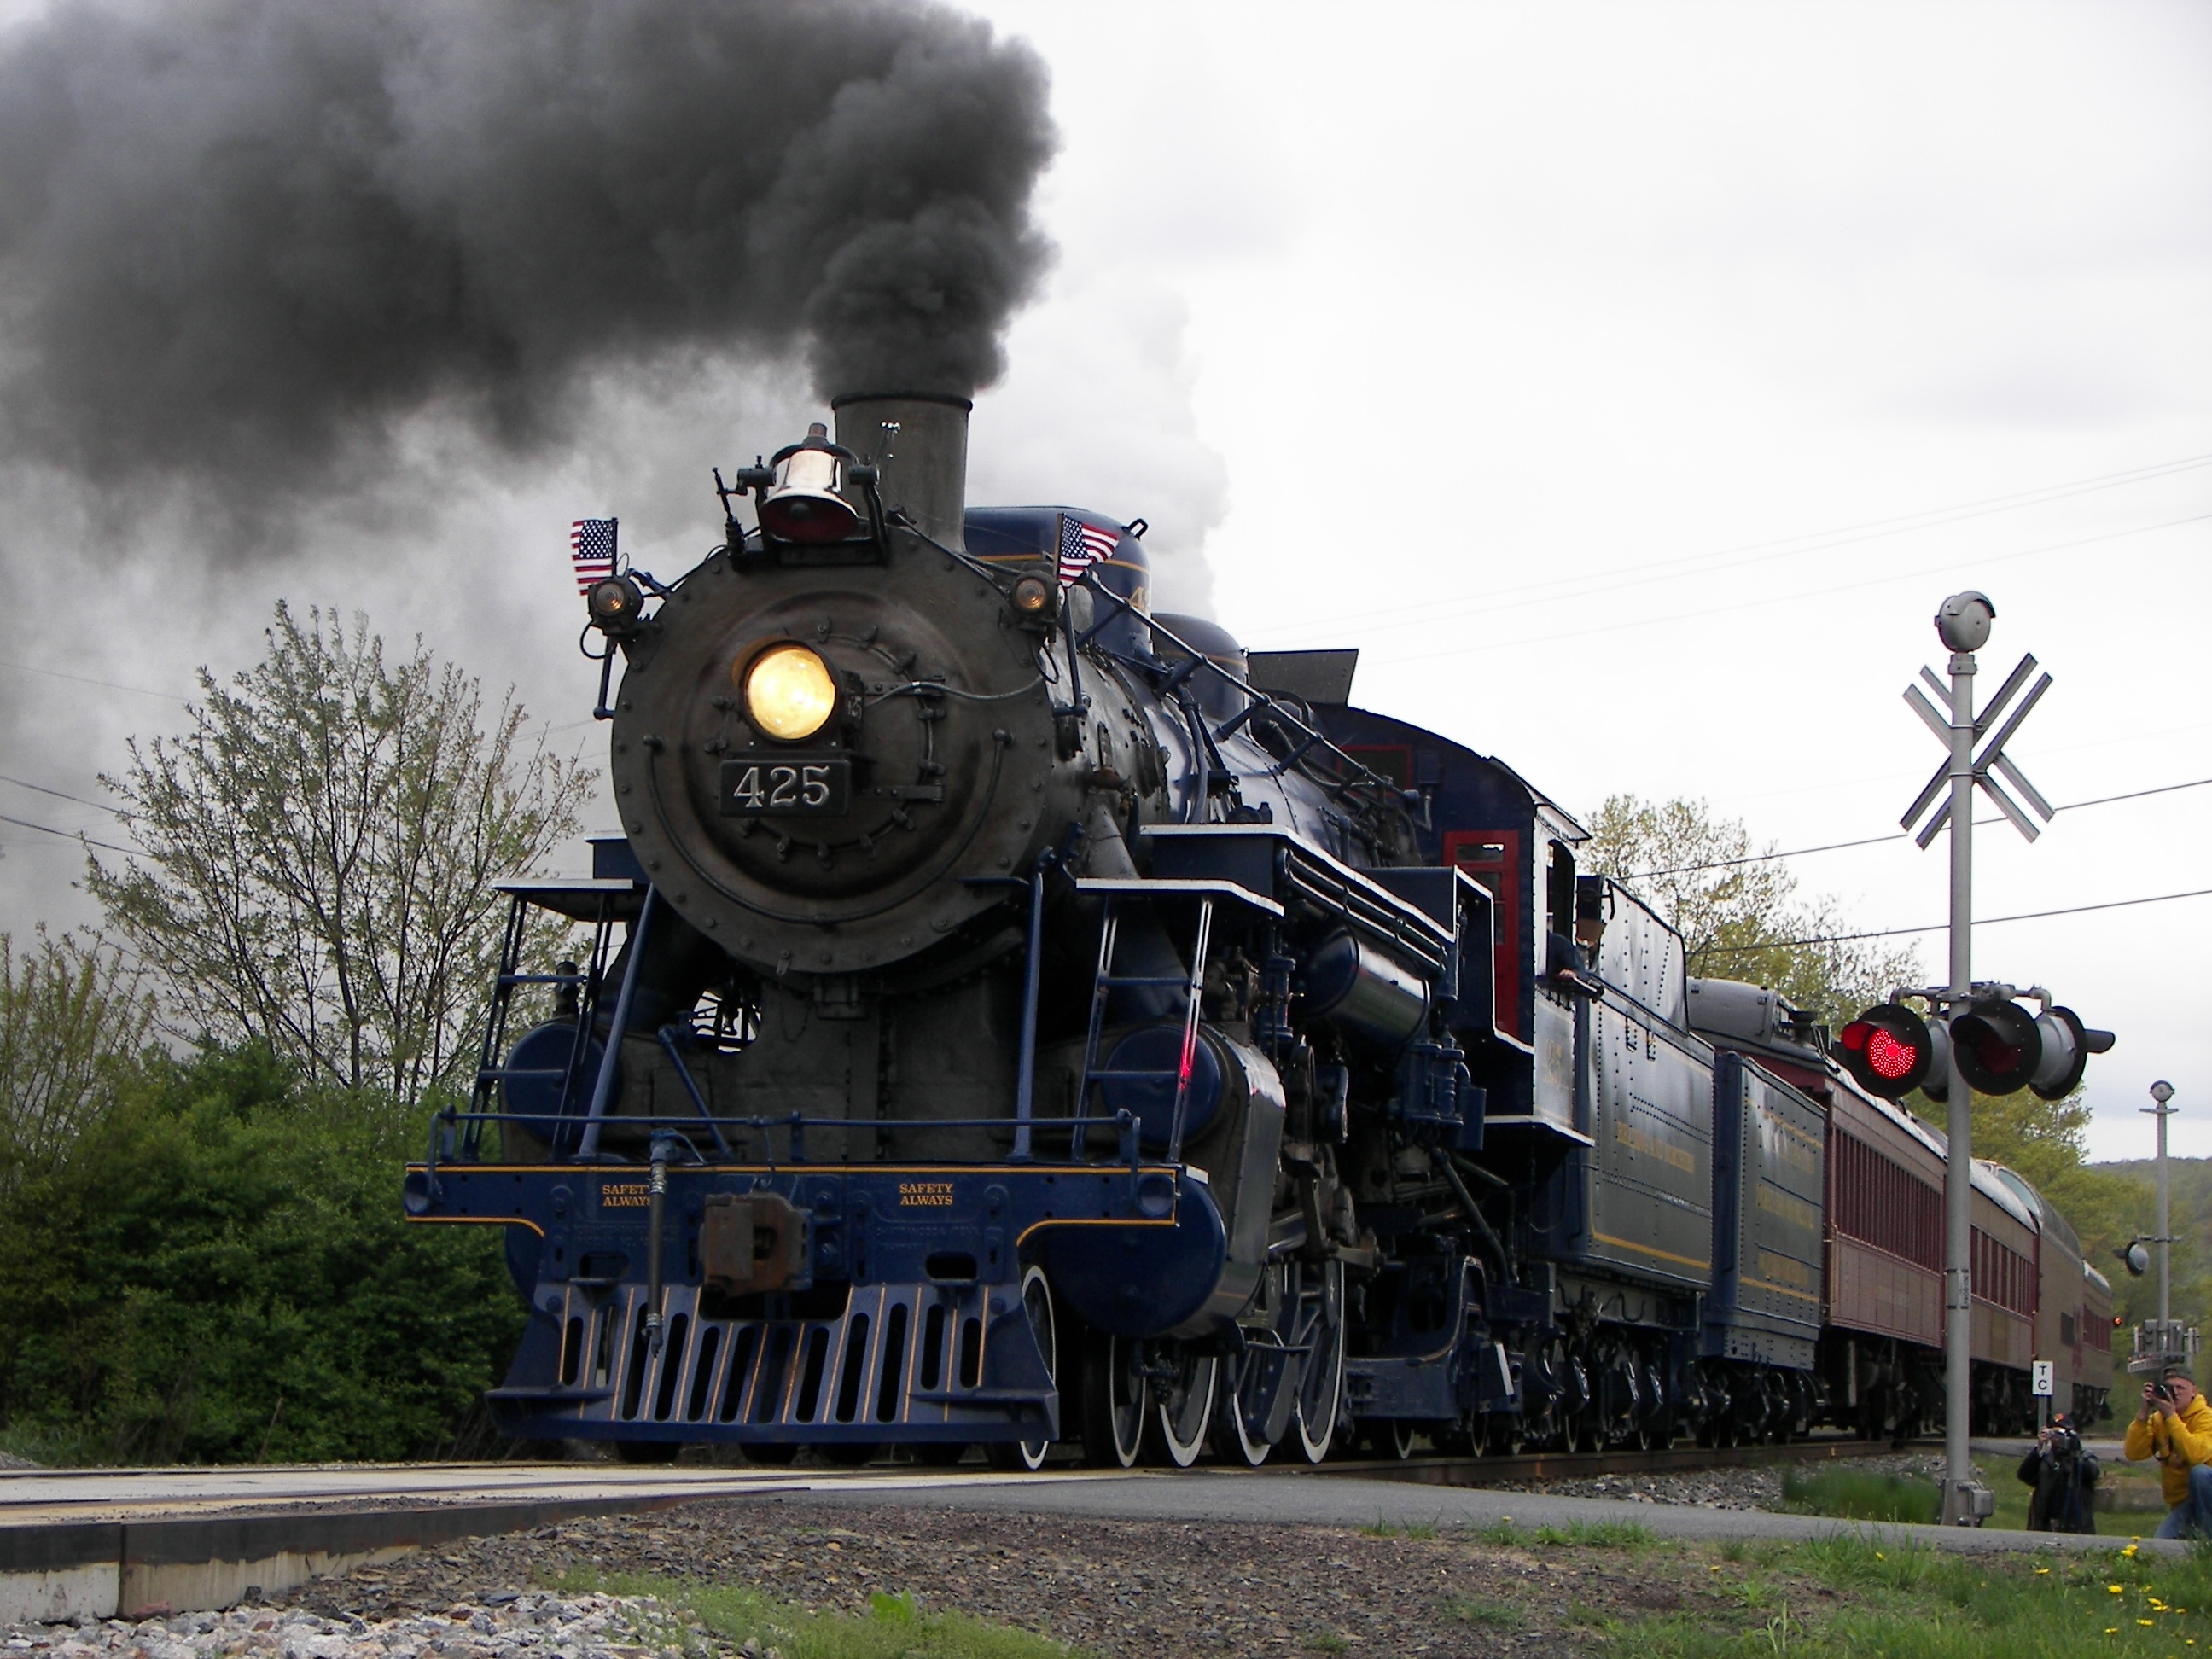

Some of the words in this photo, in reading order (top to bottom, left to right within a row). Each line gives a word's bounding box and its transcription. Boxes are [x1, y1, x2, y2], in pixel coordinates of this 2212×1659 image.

[733, 765, 830, 808] 425
[899, 1183, 954, 1194] SAFETY
[899, 1195, 954, 1206] ALWAYS
